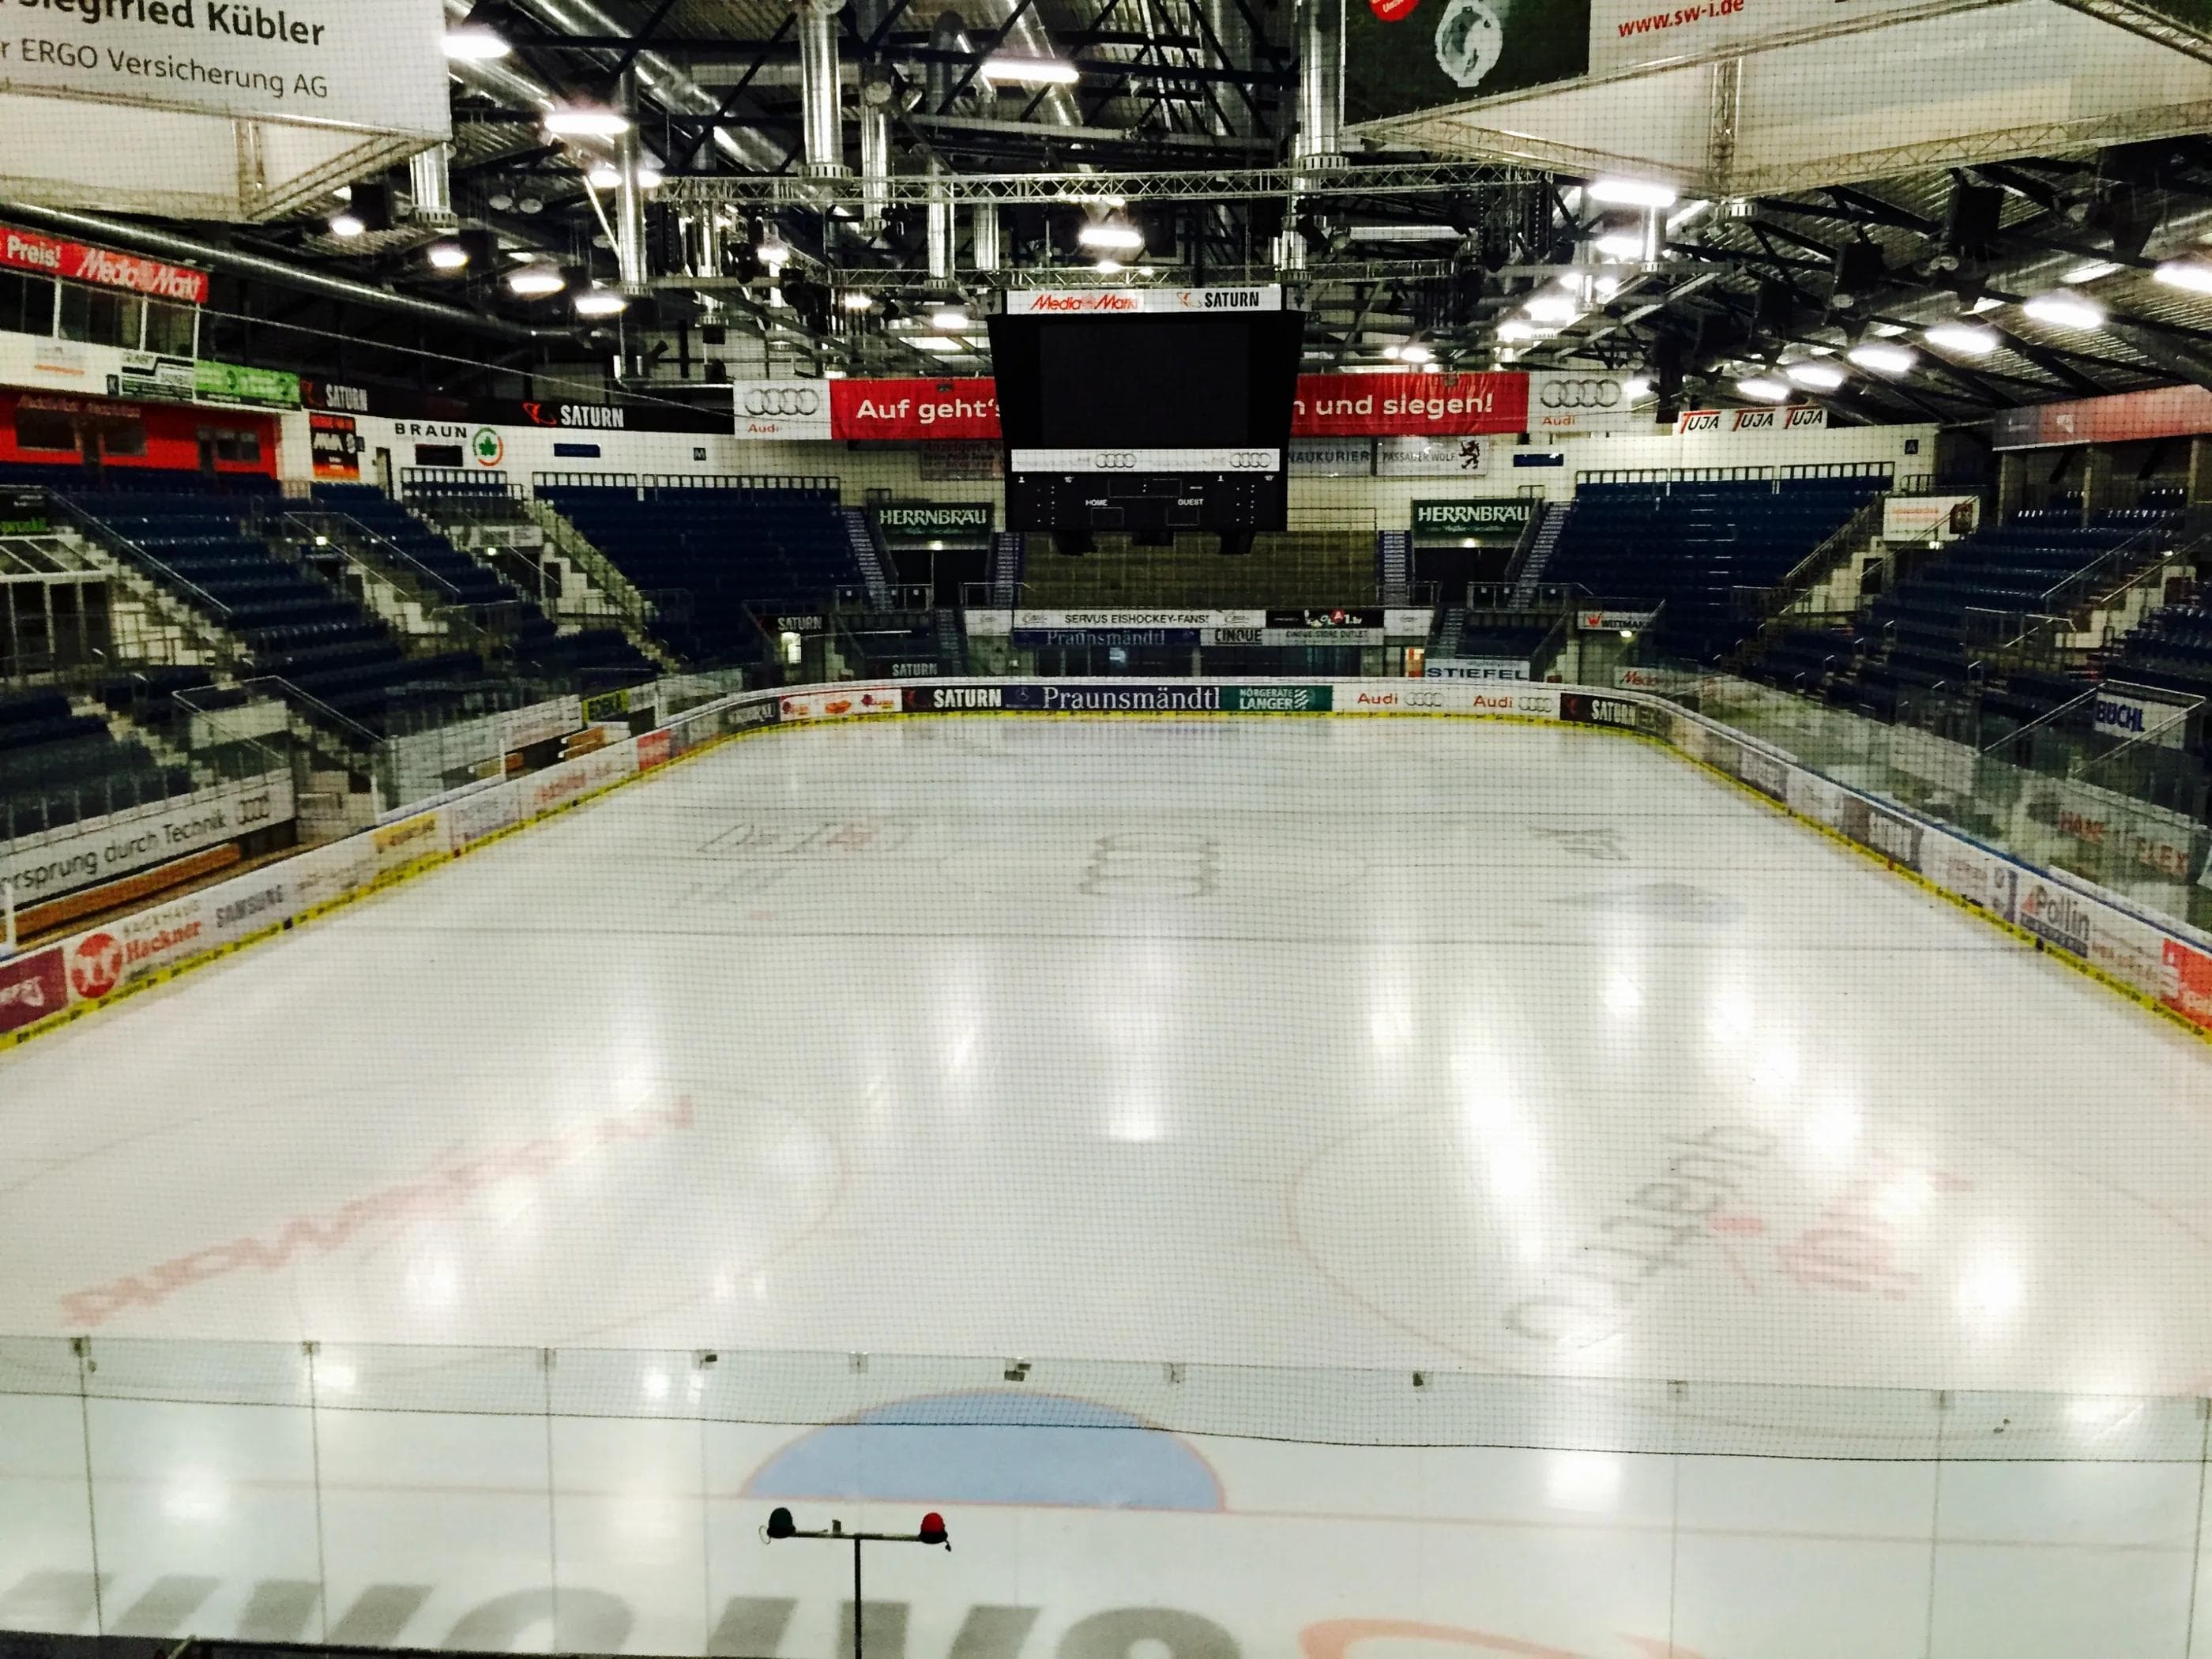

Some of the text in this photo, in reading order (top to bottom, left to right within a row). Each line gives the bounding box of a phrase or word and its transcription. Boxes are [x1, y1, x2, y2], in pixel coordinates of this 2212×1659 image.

[209, 2, 325, 45] Kübler
[1618, 0, 1744, 37] www.sw-i.de
[22, 38, 98, 69] ERGO
[107, 47, 284, 98] Versicherung
[294, 73, 327, 97] AG
[6, 235, 62, 269] Preis!
[1030, 294, 1082, 310] Media
[1204, 292, 1259, 308] SATURN
[325, 384, 367, 412] SATURN
[856, 399, 910, 418] Auf
[1316, 395, 1373, 416] und
[1383, 392, 1493, 419] siegen!
[560, 404, 624, 427] SATURN
[1542, 416, 1576, 427] Audi
[1680, 410, 1722, 434] TUJA
[1732, 408, 1776, 431] TUJA
[1784, 404, 1824, 429] TUJA
[394, 422, 468, 439] BRAUN
[748, 423, 779, 434] Audi
[1431, 452, 1456, 461] WOLF
[878, 510, 987, 525] HERRNBRÄU
[1417, 506, 1529, 521] HERRNBRÄU
[777, 617, 822, 631] SATURN
[1065, 615, 1209, 623] SERVUS EISHOCKEY-FANS!
[892, 663, 938, 677] SATURN
[1427, 668, 1529, 680] STIEFEL
[933, 688, 1002, 708] SATURN
[1043, 687, 1220, 709] Praunsmändtl
[1240, 687, 1293, 698] HÖRGERÄTE
[1357, 692, 1398, 705] Audi
[1240, 698, 1293, 709] LANGER
[1473, 694, 1514, 709] Audi
[1591, 699, 1637, 727] SATURN
[0, 809, 227, 894] orsprung durch Technik
